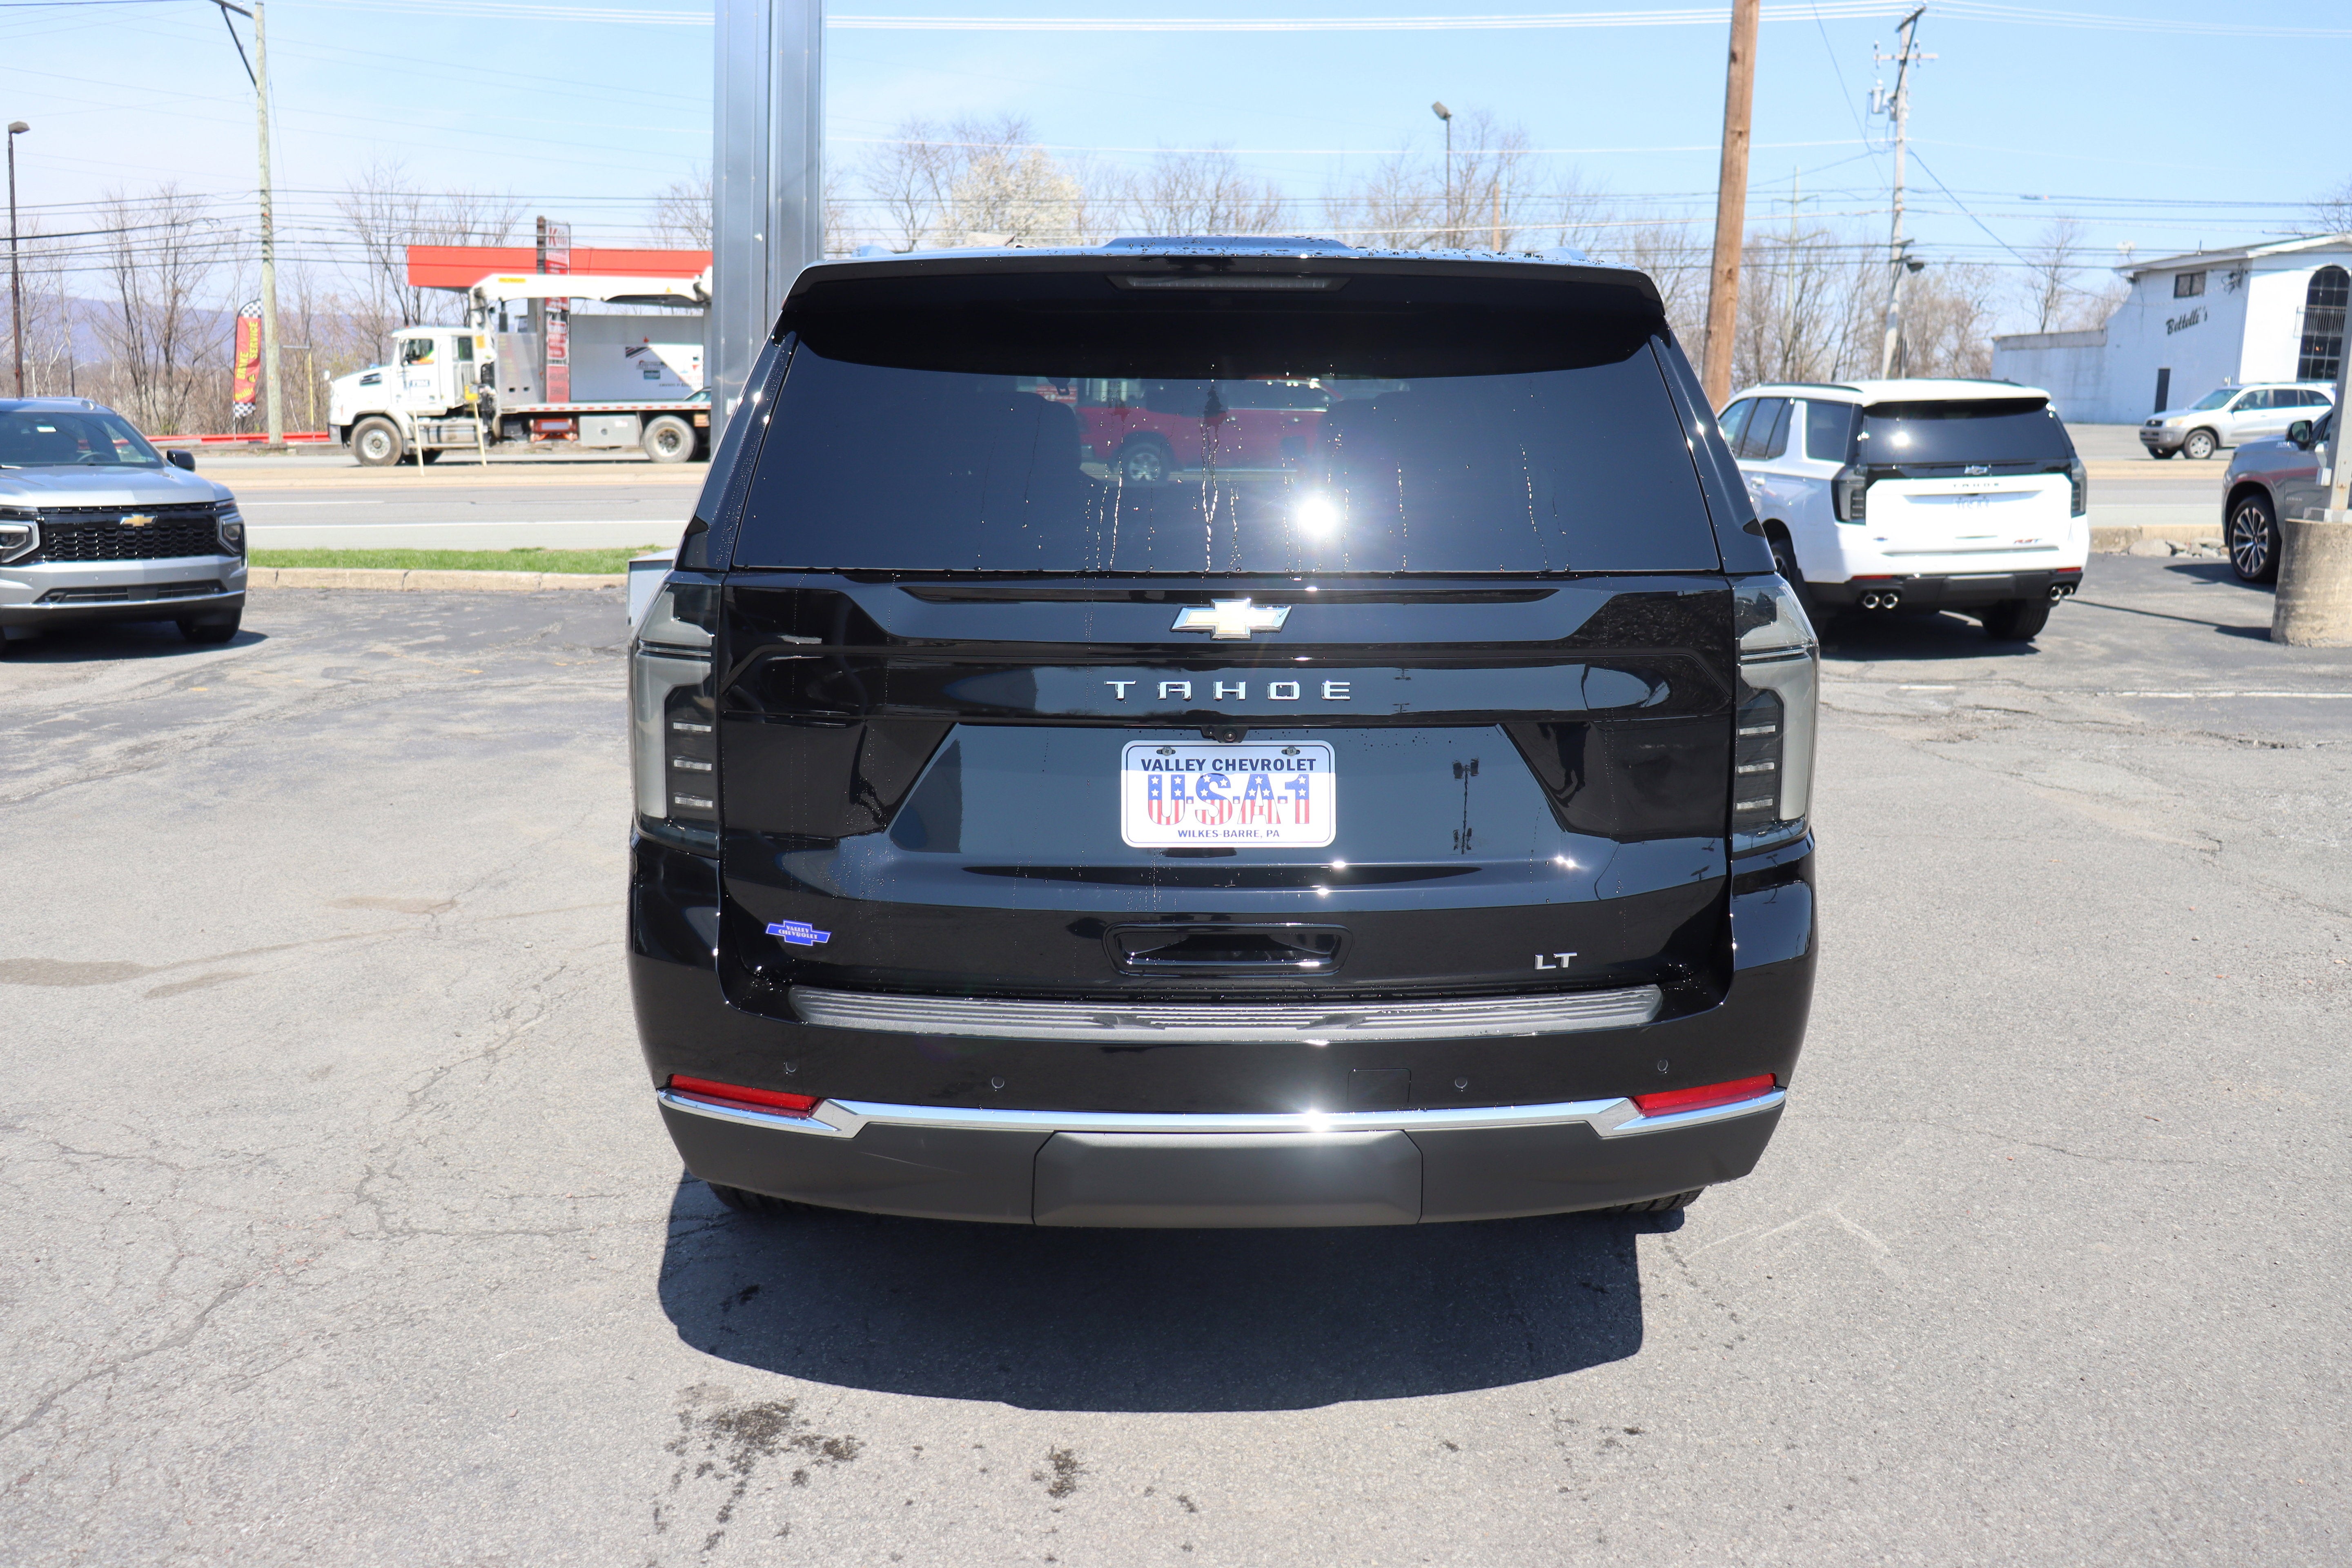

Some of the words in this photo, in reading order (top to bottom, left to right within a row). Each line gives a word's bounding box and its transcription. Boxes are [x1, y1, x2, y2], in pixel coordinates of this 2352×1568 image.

[249, 321, 258, 359] SERVICE
[236, 351, 249, 379] BRAKE
[1104, 680, 1351, 701] TAHOE
[1141, 758, 1206, 771] VALLEY
[1212, 758, 1316, 771] CHEVROLET
[1178, 829, 1263, 838] WILKES-BARRE,
[1266, 829, 1280, 837] PA
[778, 929, 817, 940] CHEVROLET
[786, 925, 810, 933] VALLEY
[1534, 952, 1577, 970] LT
